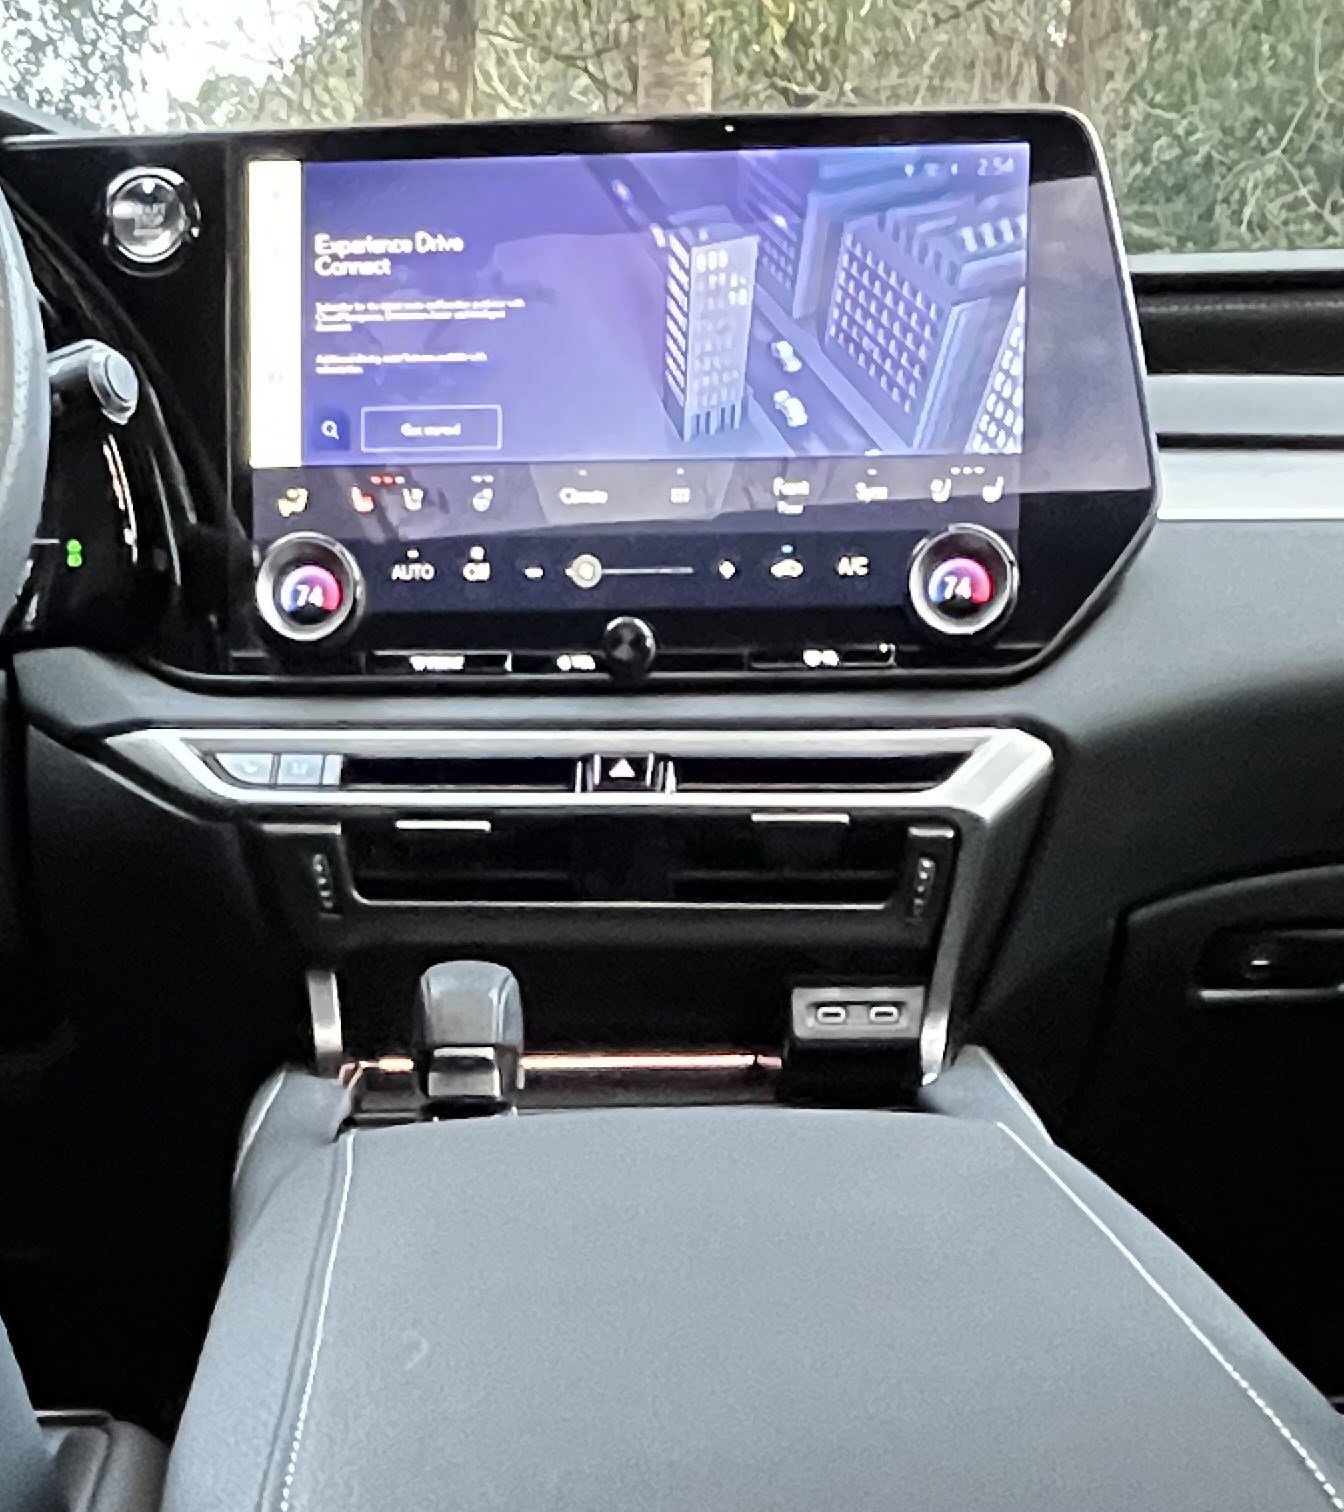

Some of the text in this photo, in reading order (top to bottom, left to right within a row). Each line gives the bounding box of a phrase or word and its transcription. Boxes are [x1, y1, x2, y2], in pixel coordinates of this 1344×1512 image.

[314, 230, 464, 258] Experience Drive
[314, 256, 391, 276] Connect
[390, 562, 435, 581] AUTO
[836, 555, 869, 576] A/C
[296, 584, 324, 607] 74
[944, 575, 972, 600] 74
